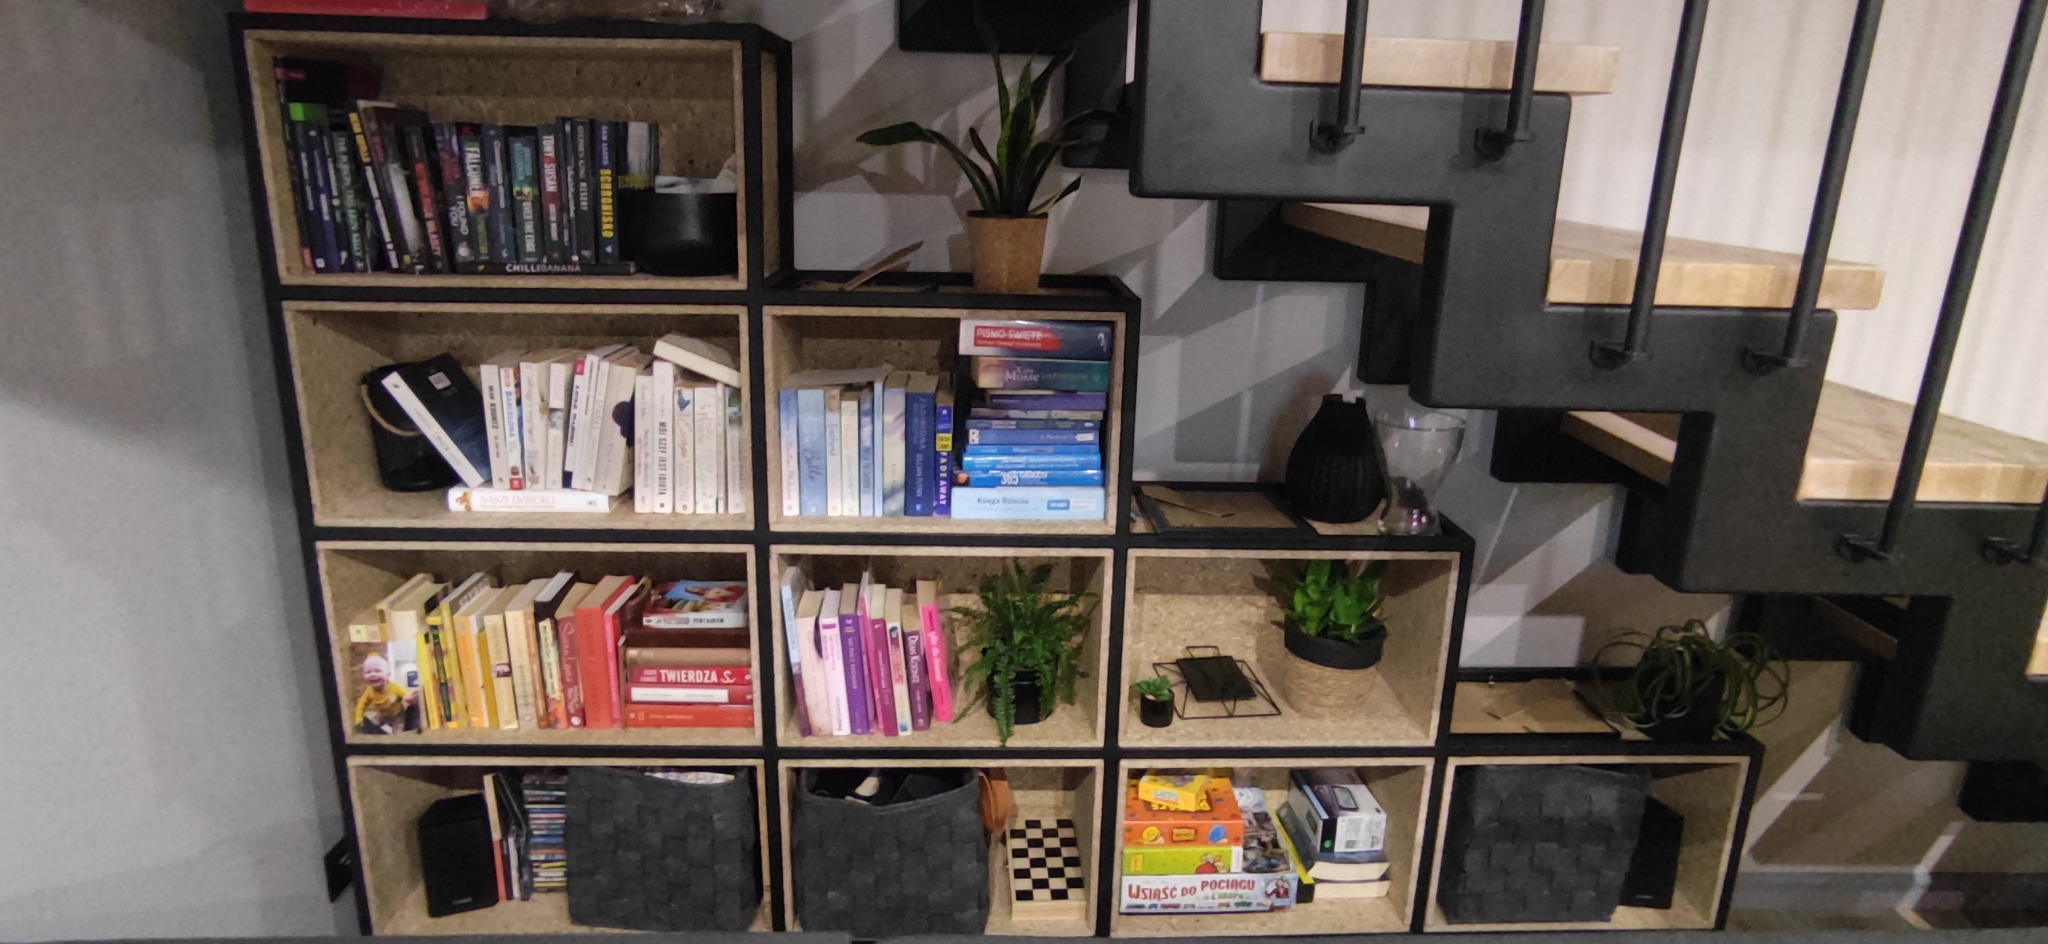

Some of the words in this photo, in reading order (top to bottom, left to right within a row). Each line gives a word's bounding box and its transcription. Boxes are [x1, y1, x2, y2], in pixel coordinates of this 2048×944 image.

[543, 135, 556, 157] TONY
[544, 163, 558, 192] SUSAN
[523, 202, 534, 220] OVER
[600, 168, 614, 239] SCHRONISKO
[448, 205, 460, 227] YOU
[457, 201, 470, 236] FOUND
[505, 262, 581, 273] CHILLIBANANA
[977, 328, 1006, 339] PISMO
[1005, 370, 1040, 382] Mosse
[505, 391, 515, 438] BARCELONA
[658, 421, 667, 435] MÓJ
[658, 437, 667, 454] SZEF
[658, 456, 667, 471] JEST
[803, 448, 822, 482] Belle
[939, 451, 948, 478] FADE
[939, 480, 948, 505] AWAY
[907, 635, 918, 655] DEAN
[659, 669, 718, 683] TWIERDZA
[910, 655, 920, 684] KOONTZ
[1181, 886, 1197, 897] DO
